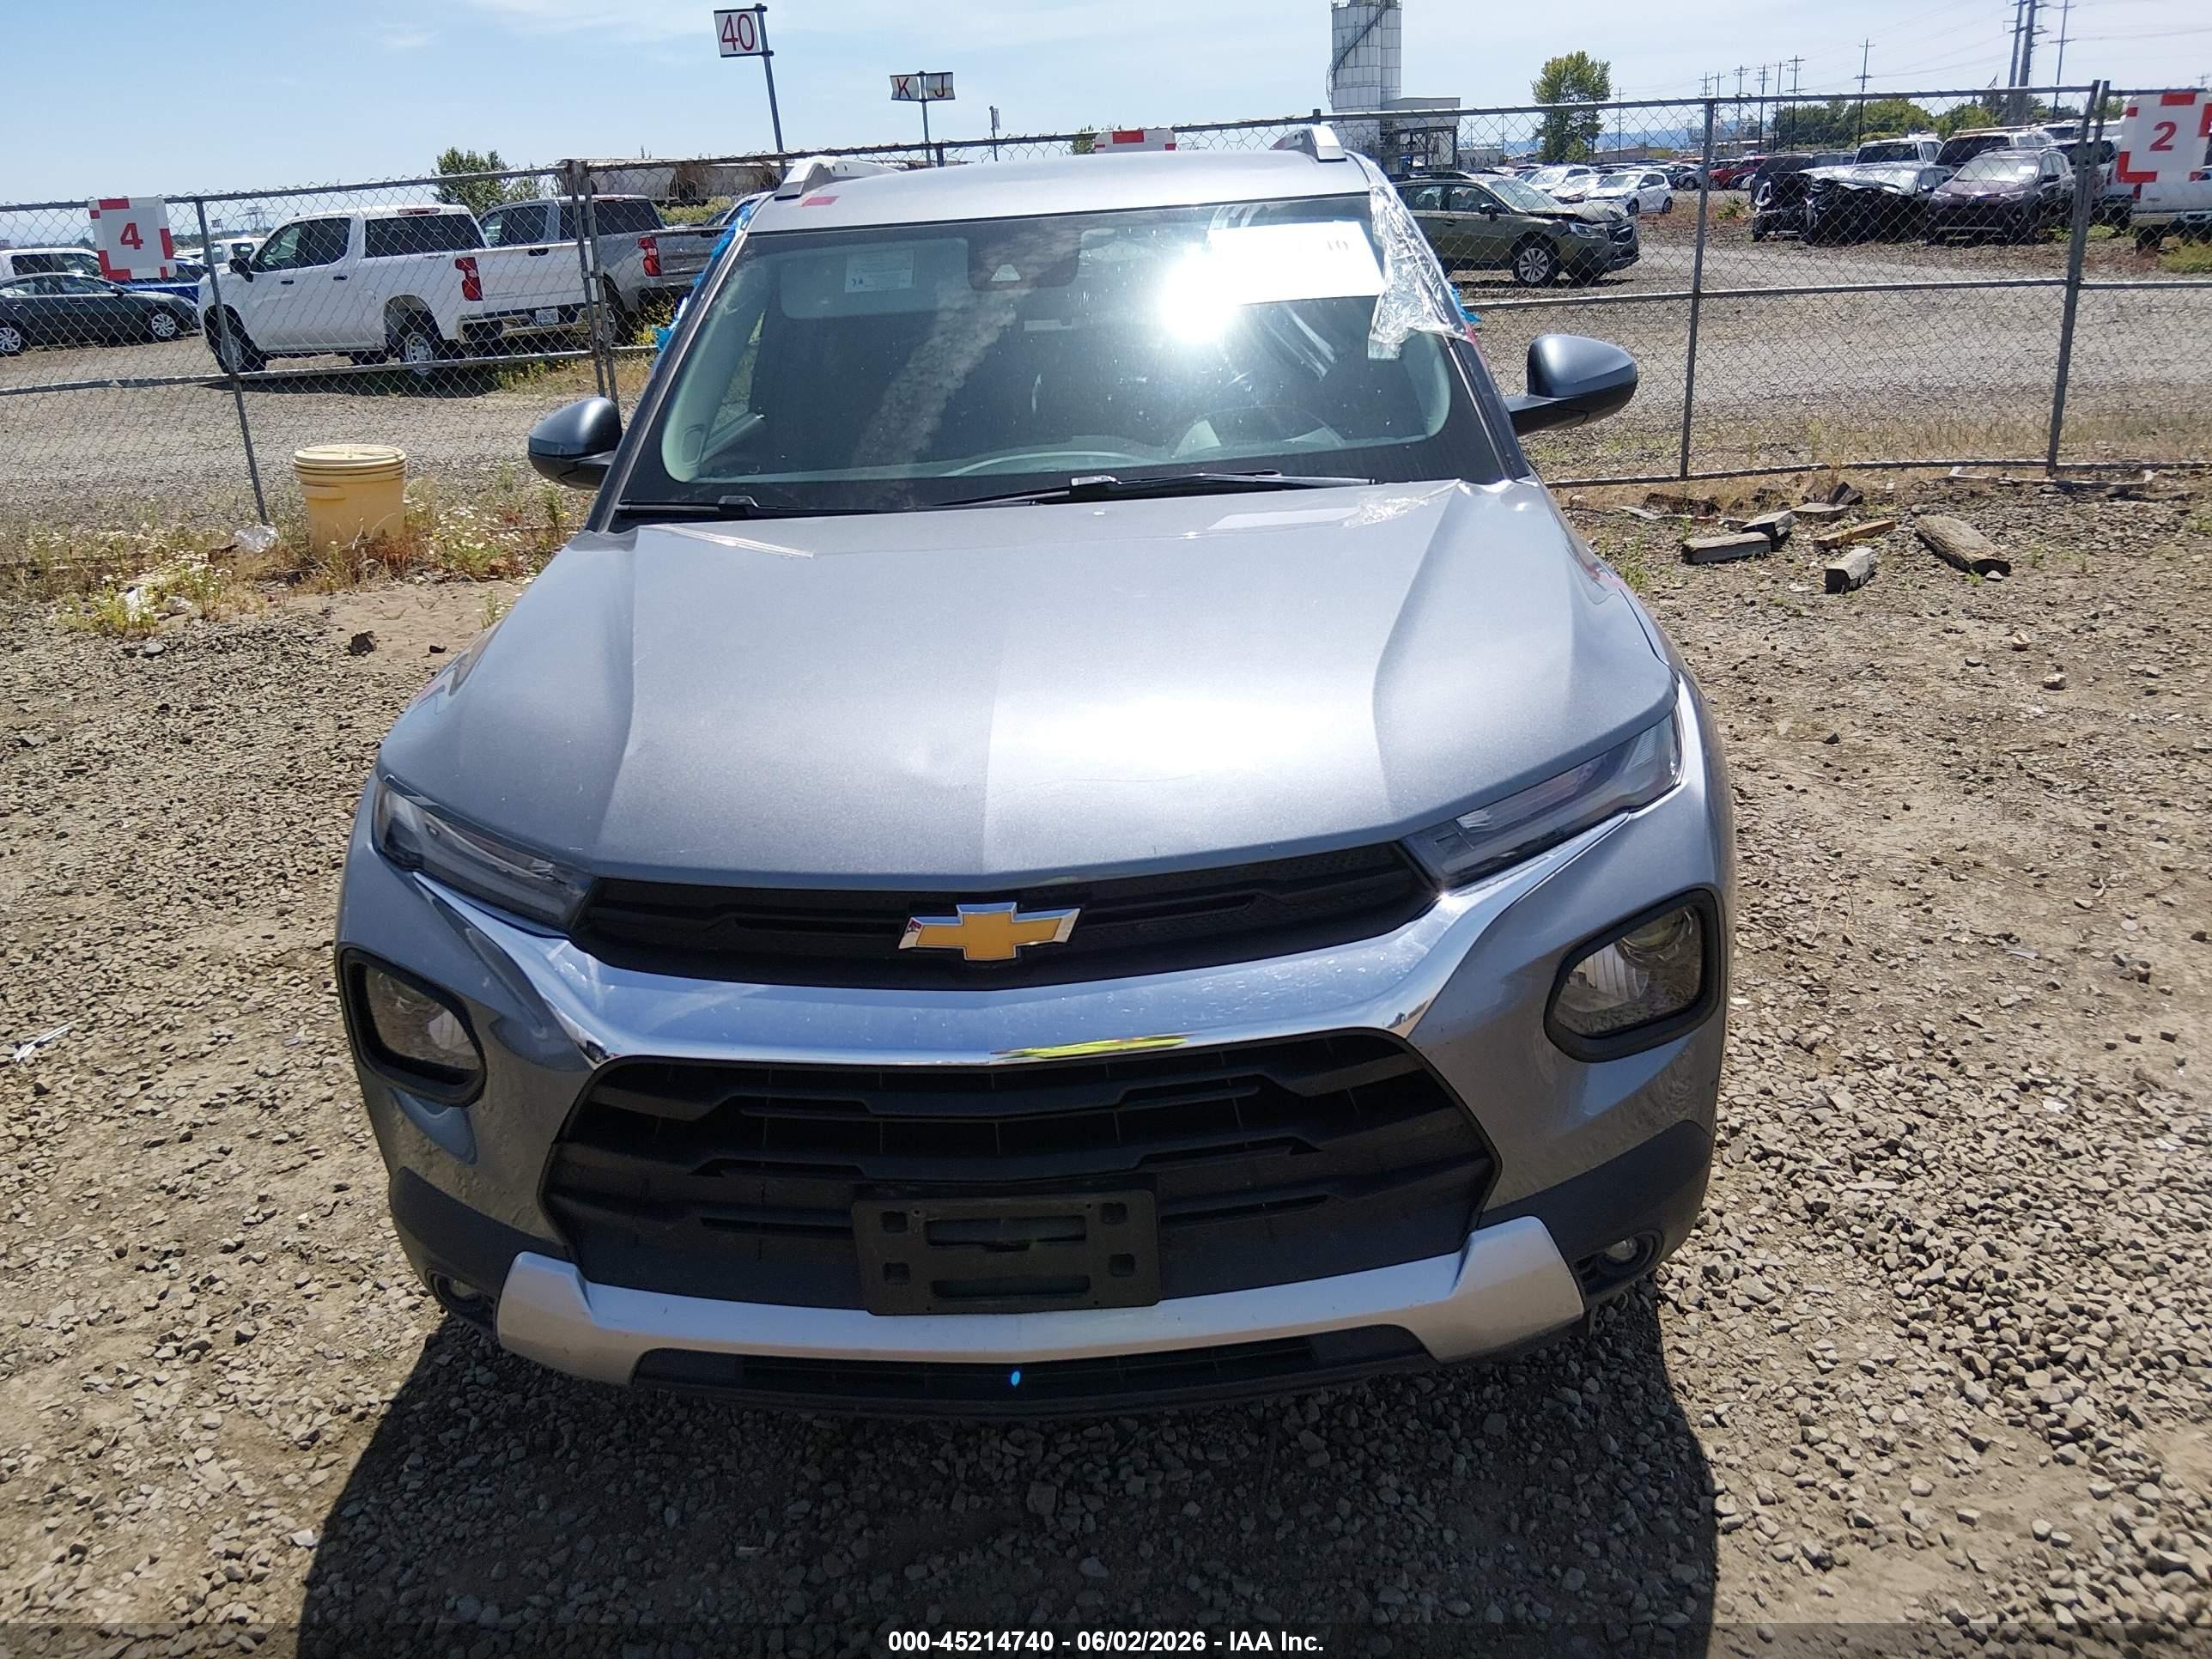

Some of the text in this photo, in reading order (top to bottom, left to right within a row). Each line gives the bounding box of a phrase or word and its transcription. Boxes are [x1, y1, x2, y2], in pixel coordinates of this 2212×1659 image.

[721, 13, 755, 51] 40
[896, 75, 945, 99] K J
[2149, 121, 2177, 152] 2
[120, 222, 143, 250] 4
